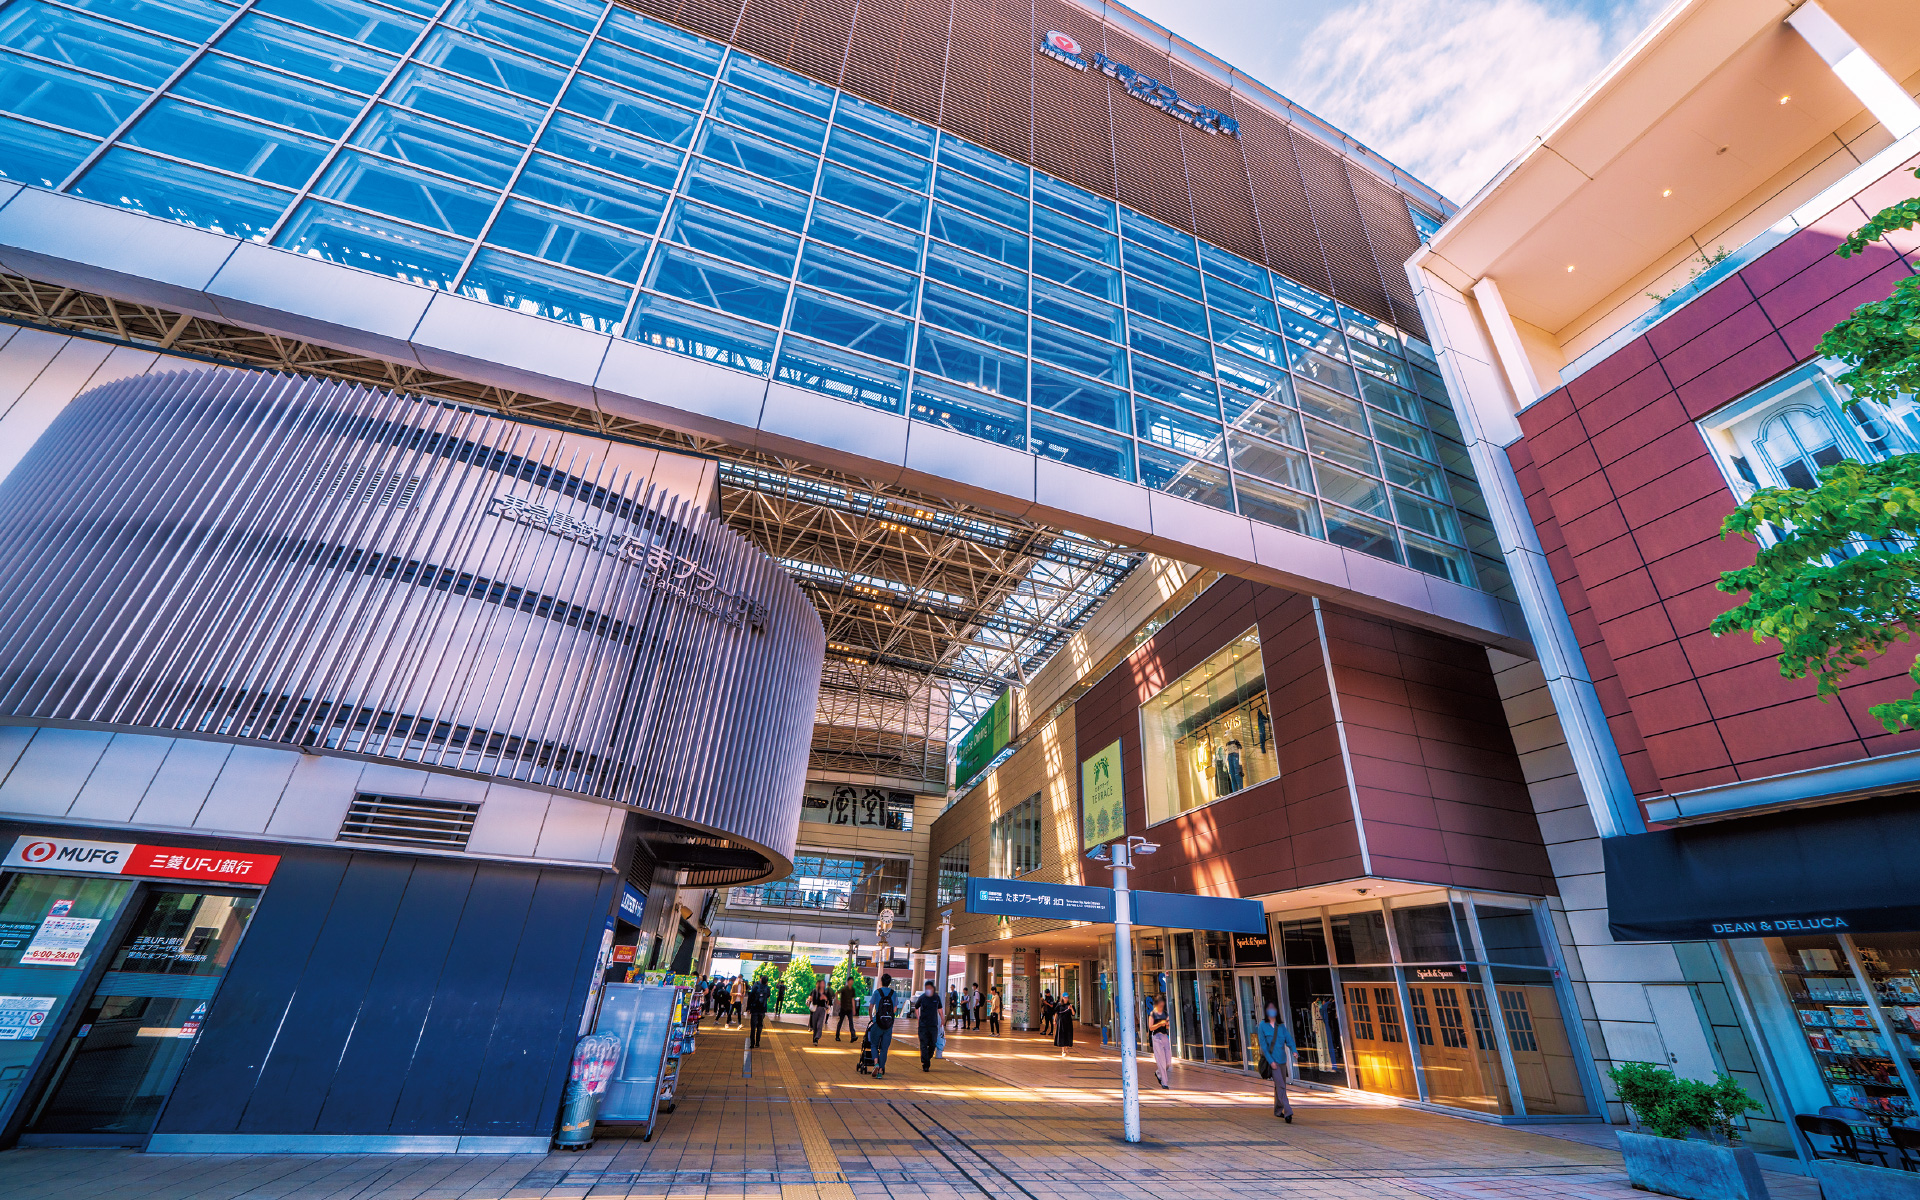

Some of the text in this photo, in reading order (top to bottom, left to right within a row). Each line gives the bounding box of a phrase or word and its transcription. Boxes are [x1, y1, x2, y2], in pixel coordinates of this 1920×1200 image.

[499, 494, 769, 634] 東急電鉄 たまプラーザ駅
[1092, 785, 1113, 804] TERRACE
[56, 846, 120, 864] MUFG
[149, 854, 254, 876] 三菱UFJ銀行
[1005, 893, 1051, 906] たまプラーザ駅
[1712, 917, 1849, 933] DEAN & DELUCA
